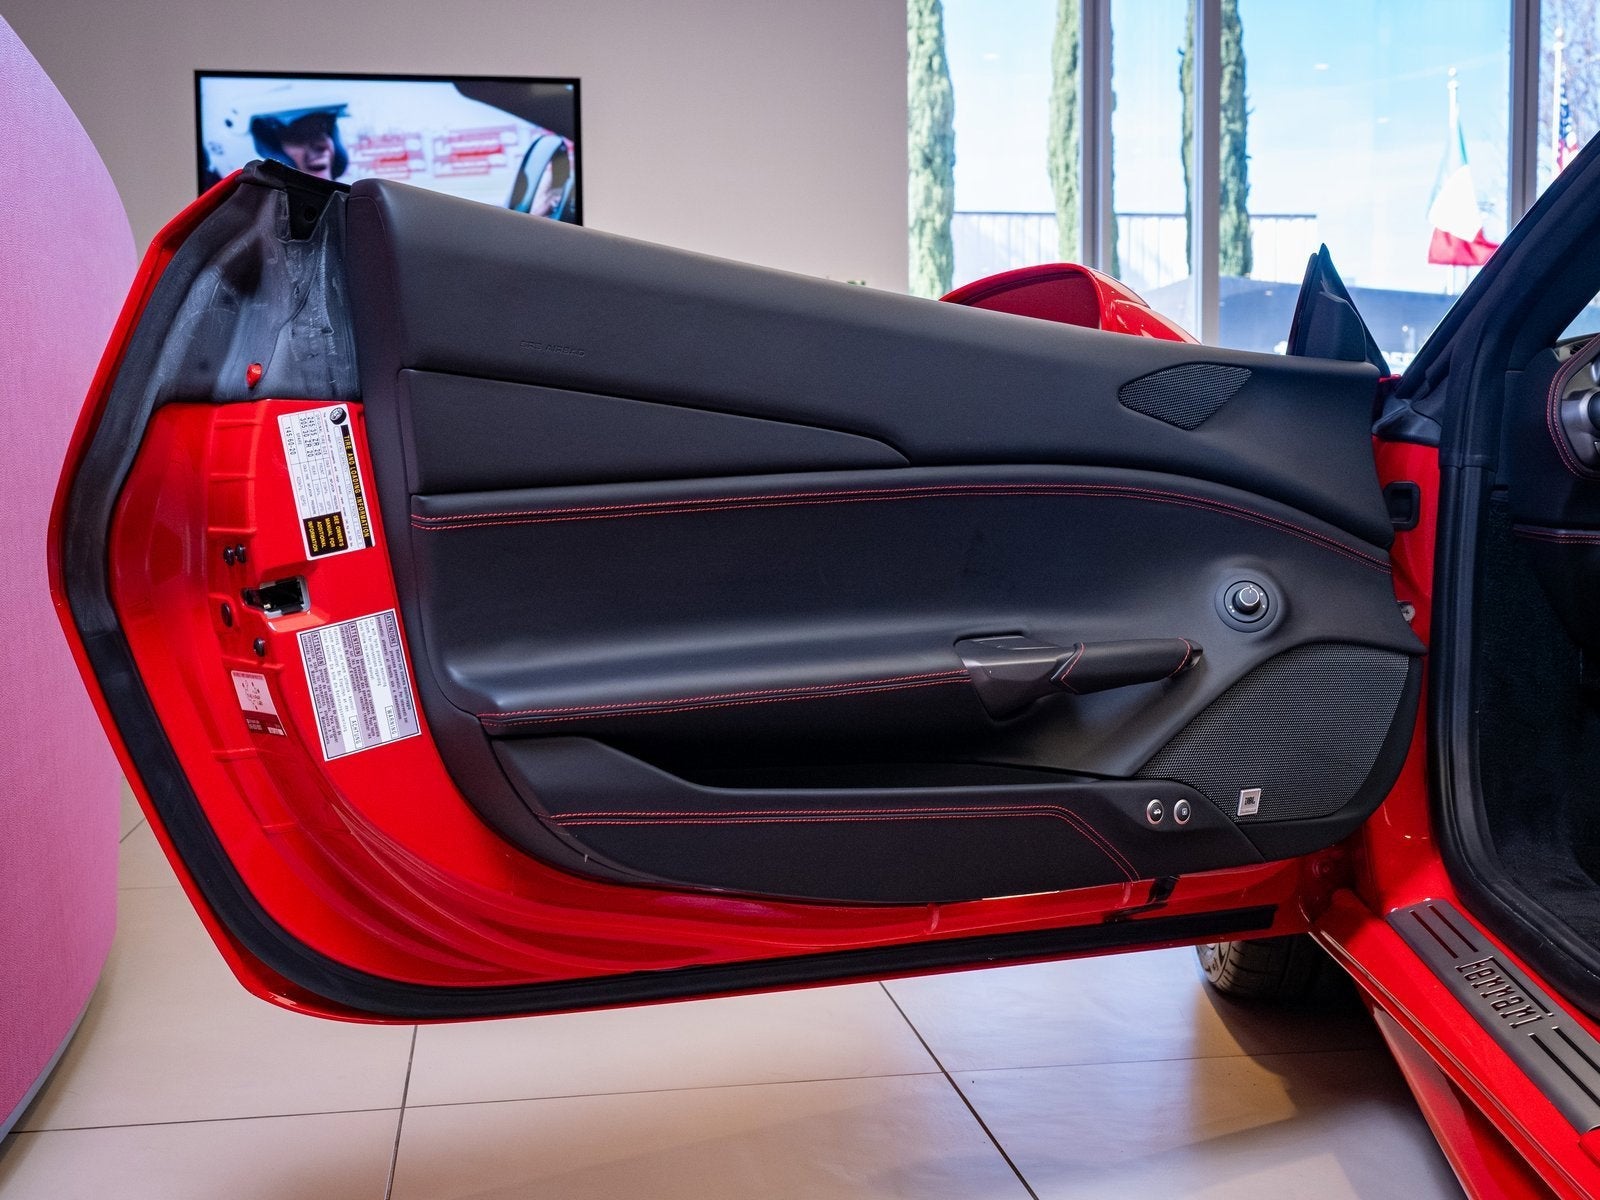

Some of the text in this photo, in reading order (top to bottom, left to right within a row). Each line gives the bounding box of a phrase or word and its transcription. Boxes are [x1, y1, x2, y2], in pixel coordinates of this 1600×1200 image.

[314, 448, 322, 456] 20
[344, 435, 369, 537] TIRE AND LOADING INFORMATION
[308, 521, 318, 552] INFORMATION
[316, 521, 326, 548] ADDITIONAL
[325, 518, 333, 536] MANUAL
[335, 525, 344, 547] OWNER'S
[349, 624, 362, 655] ATTENTION
[385, 615, 397, 644] ATTENZIONE
[351, 720, 362, 745] ACHTUNG
[387, 709, 397, 735] WARNING
[1244, 796, 1256, 805] JBL
[1454, 955, 1554, 1029] Ferrari
